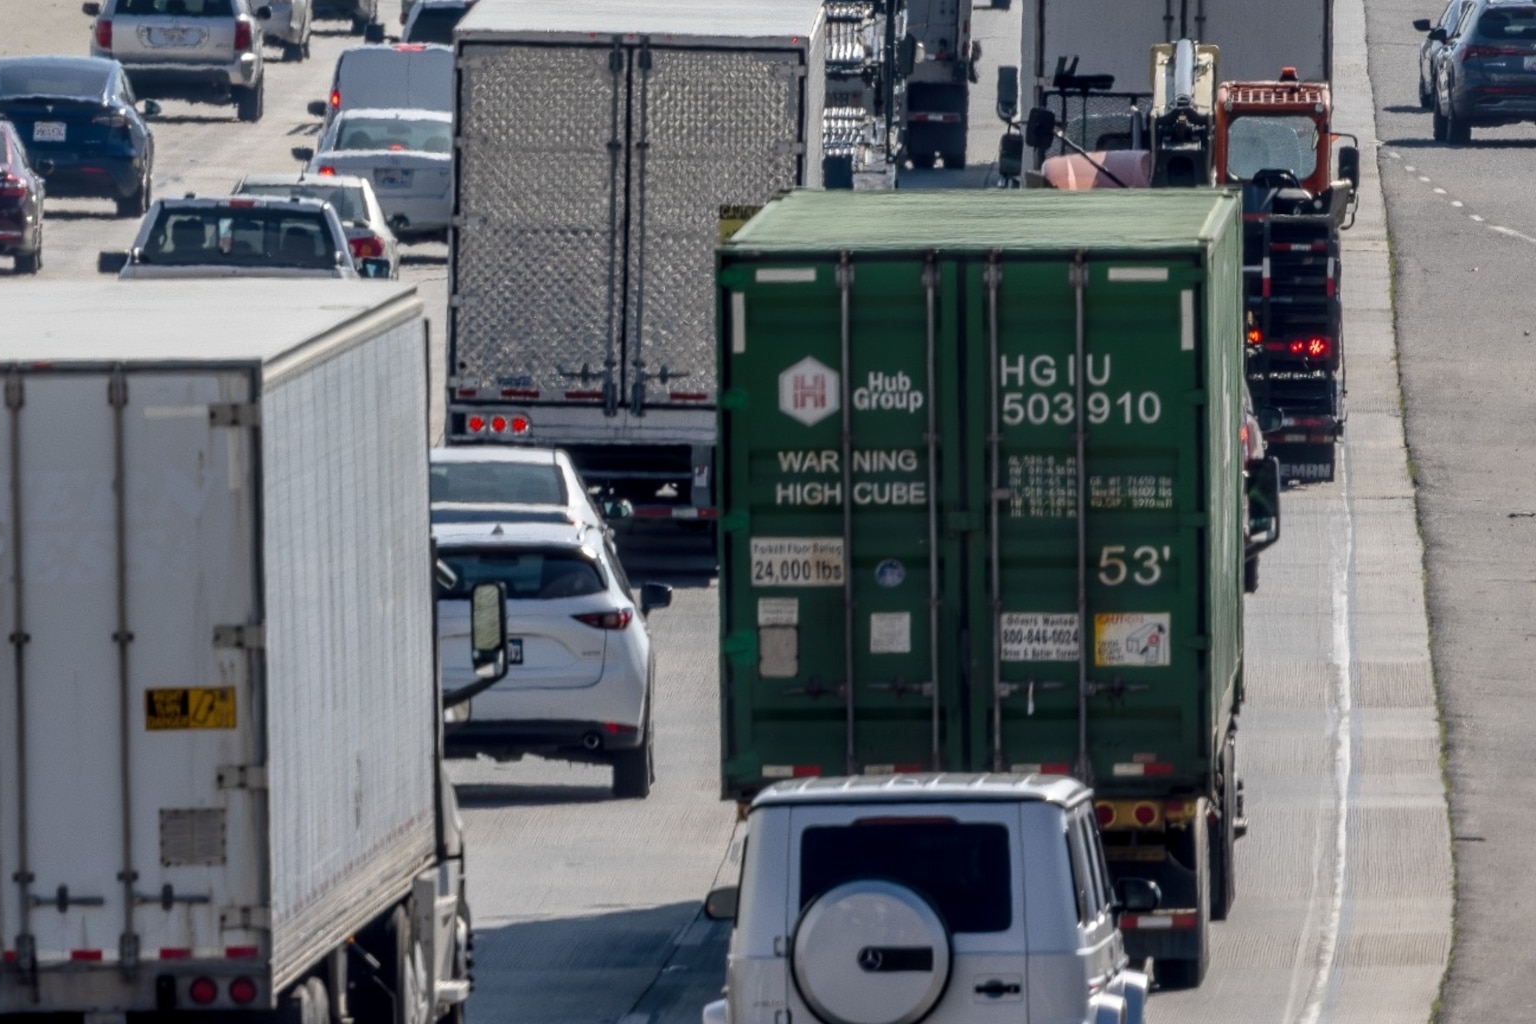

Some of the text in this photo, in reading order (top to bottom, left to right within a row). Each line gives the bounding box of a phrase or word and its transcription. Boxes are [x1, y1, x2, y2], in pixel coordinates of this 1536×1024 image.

[868, 371, 910, 391] Hub
[852, 387, 924, 414] Group
[1002, 391, 1161, 425] 503910
[775, 482, 926, 506] HIGH CUBE
[754, 560, 842, 583] 24,000 lbs
[1098, 545, 1171, 586] 53'
